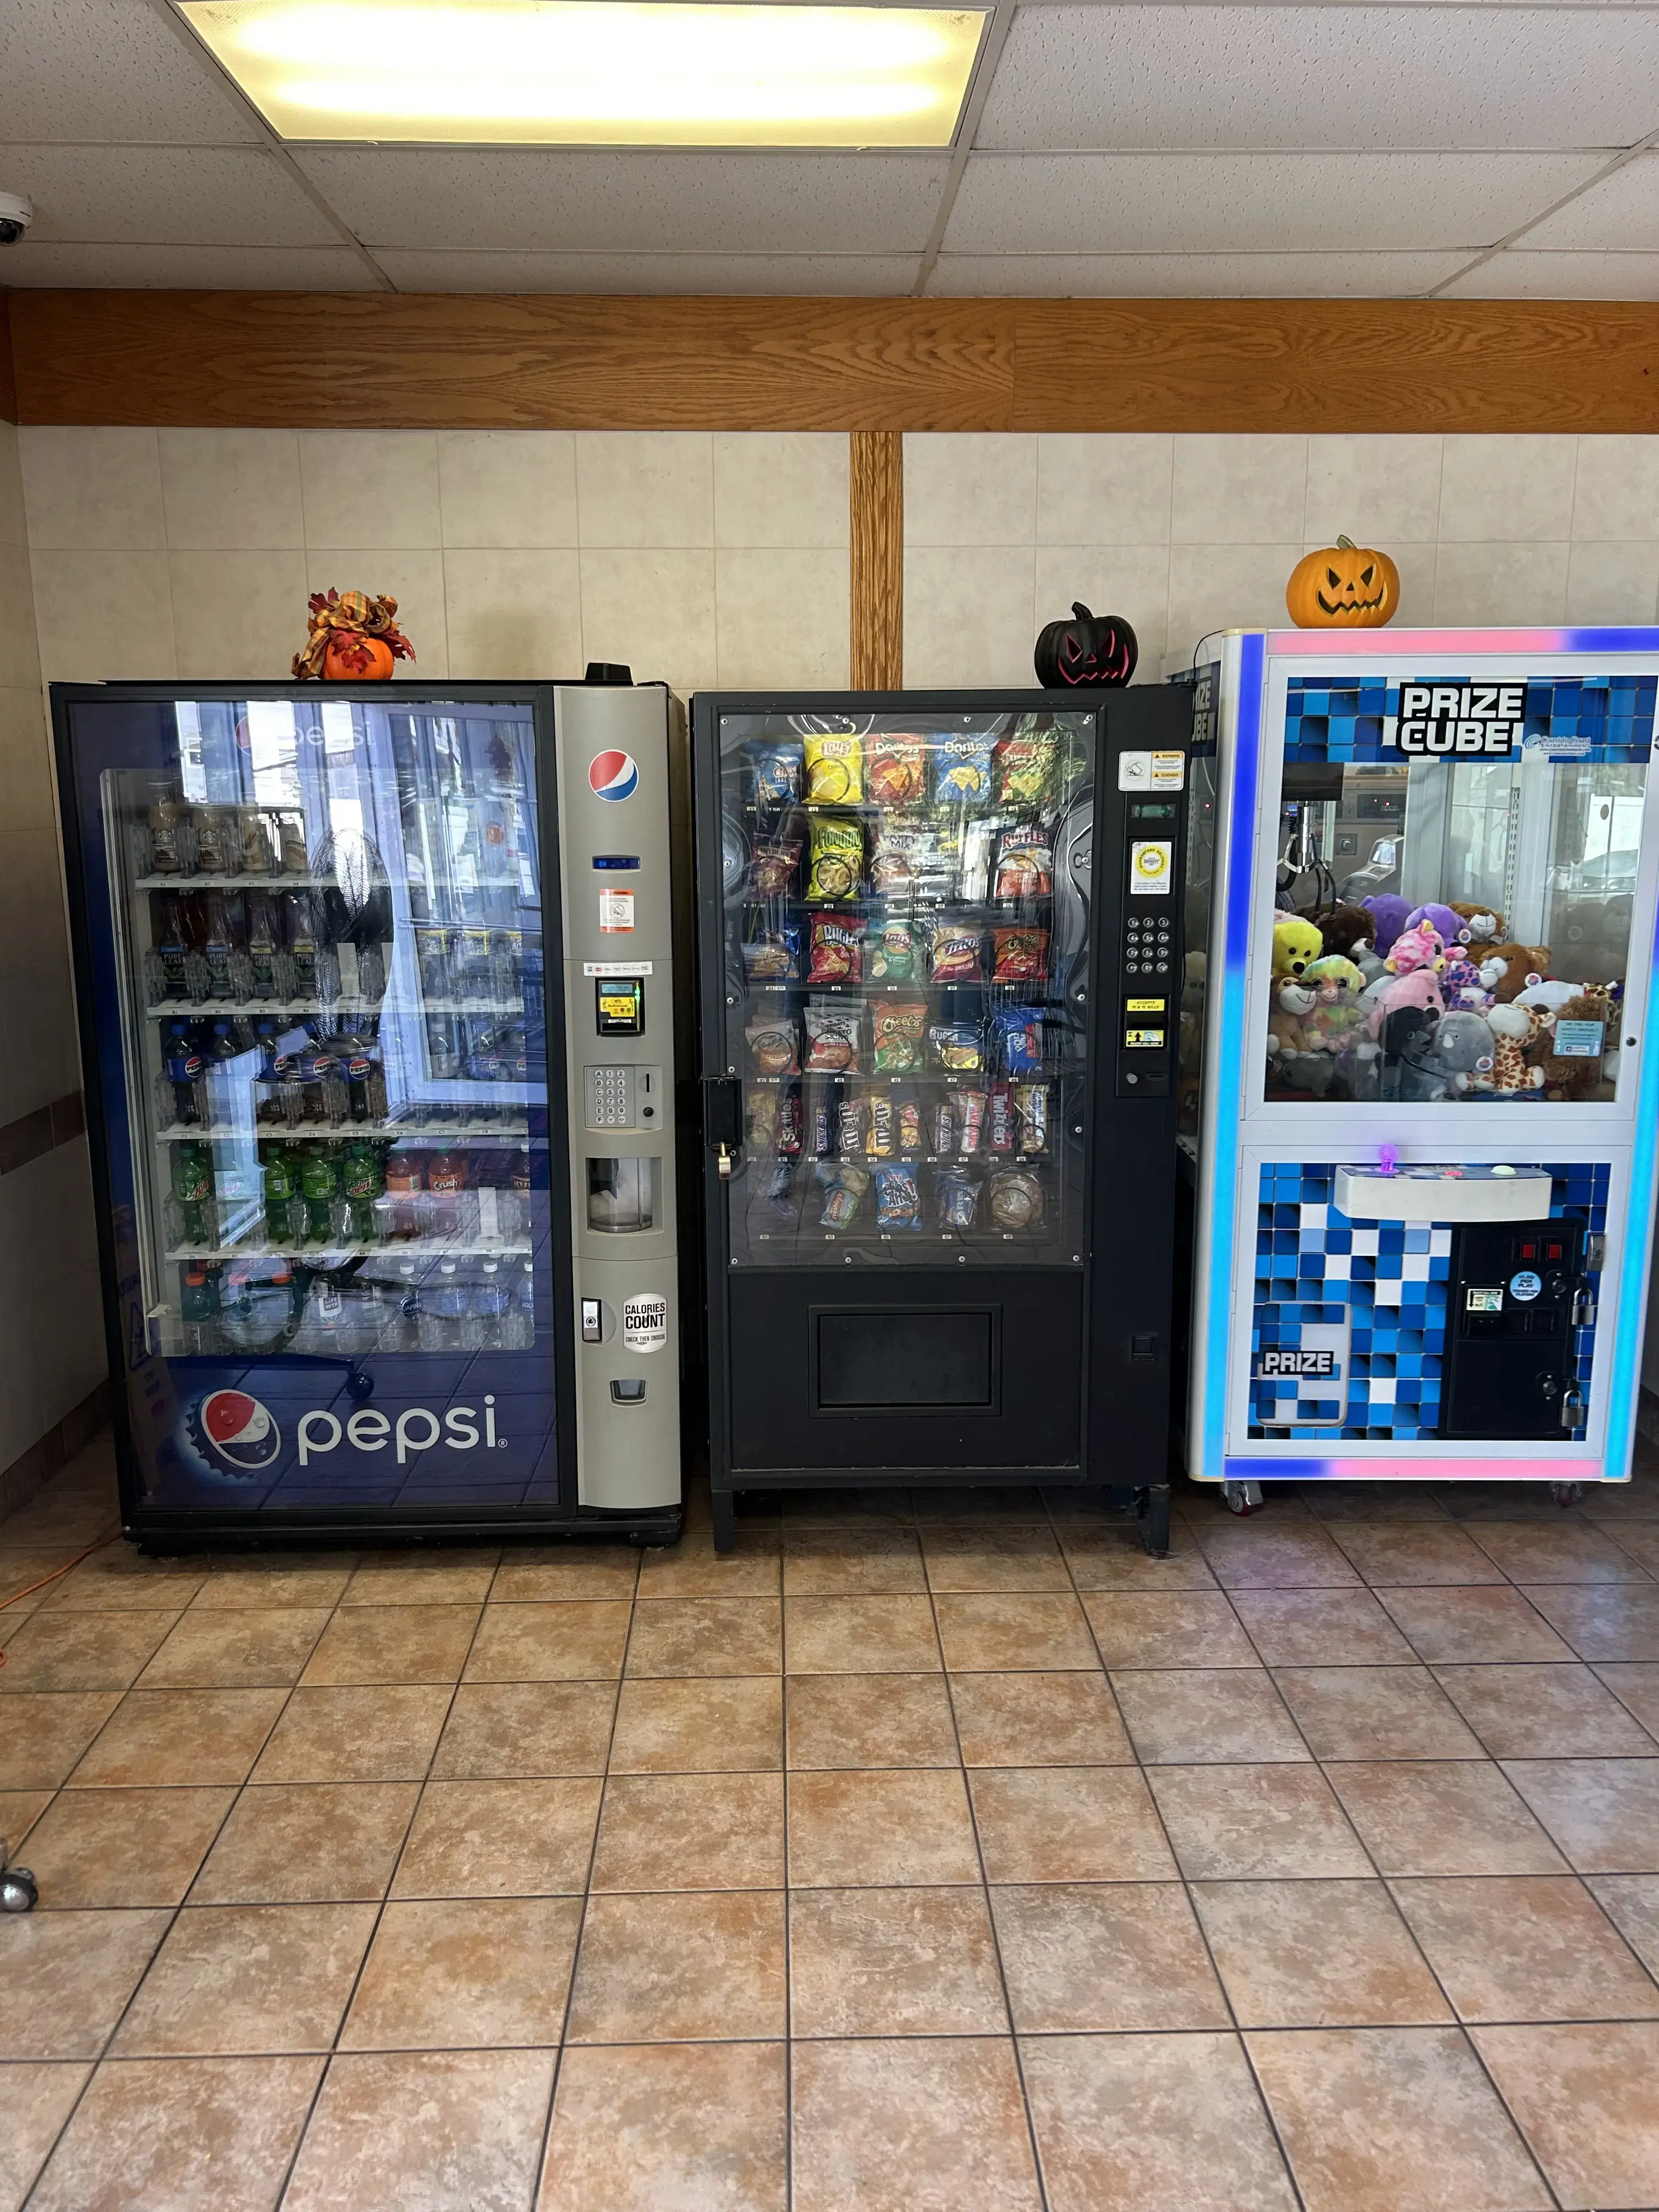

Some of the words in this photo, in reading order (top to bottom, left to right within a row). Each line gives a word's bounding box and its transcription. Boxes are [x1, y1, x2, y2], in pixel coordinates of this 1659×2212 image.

[1403, 687, 1523, 718] PRIZE
[1401, 721, 1510, 752] CUBE
[875, 742, 920, 755] Doritos
[944, 741, 990, 753] Doritos
[891, 840, 910, 850] MIX
[1002, 832, 1049, 848] RUFFLES
[946, 938, 980, 956] Fritos
[881, 1015, 923, 1033] Cheetos
[781, 1098, 796, 1142] Skittles
[816, 1114, 828, 1152] SNICKERS
[940, 1115, 952, 1152] SNICKERS
[433, 1178, 459, 1191] Crush
[625, 1302, 665, 1314] CALORIES
[625, 1313, 665, 1329] COUNT
[1265, 1352, 1331, 1372] PRIZE
[297, 1394, 496, 1466] pepsi
